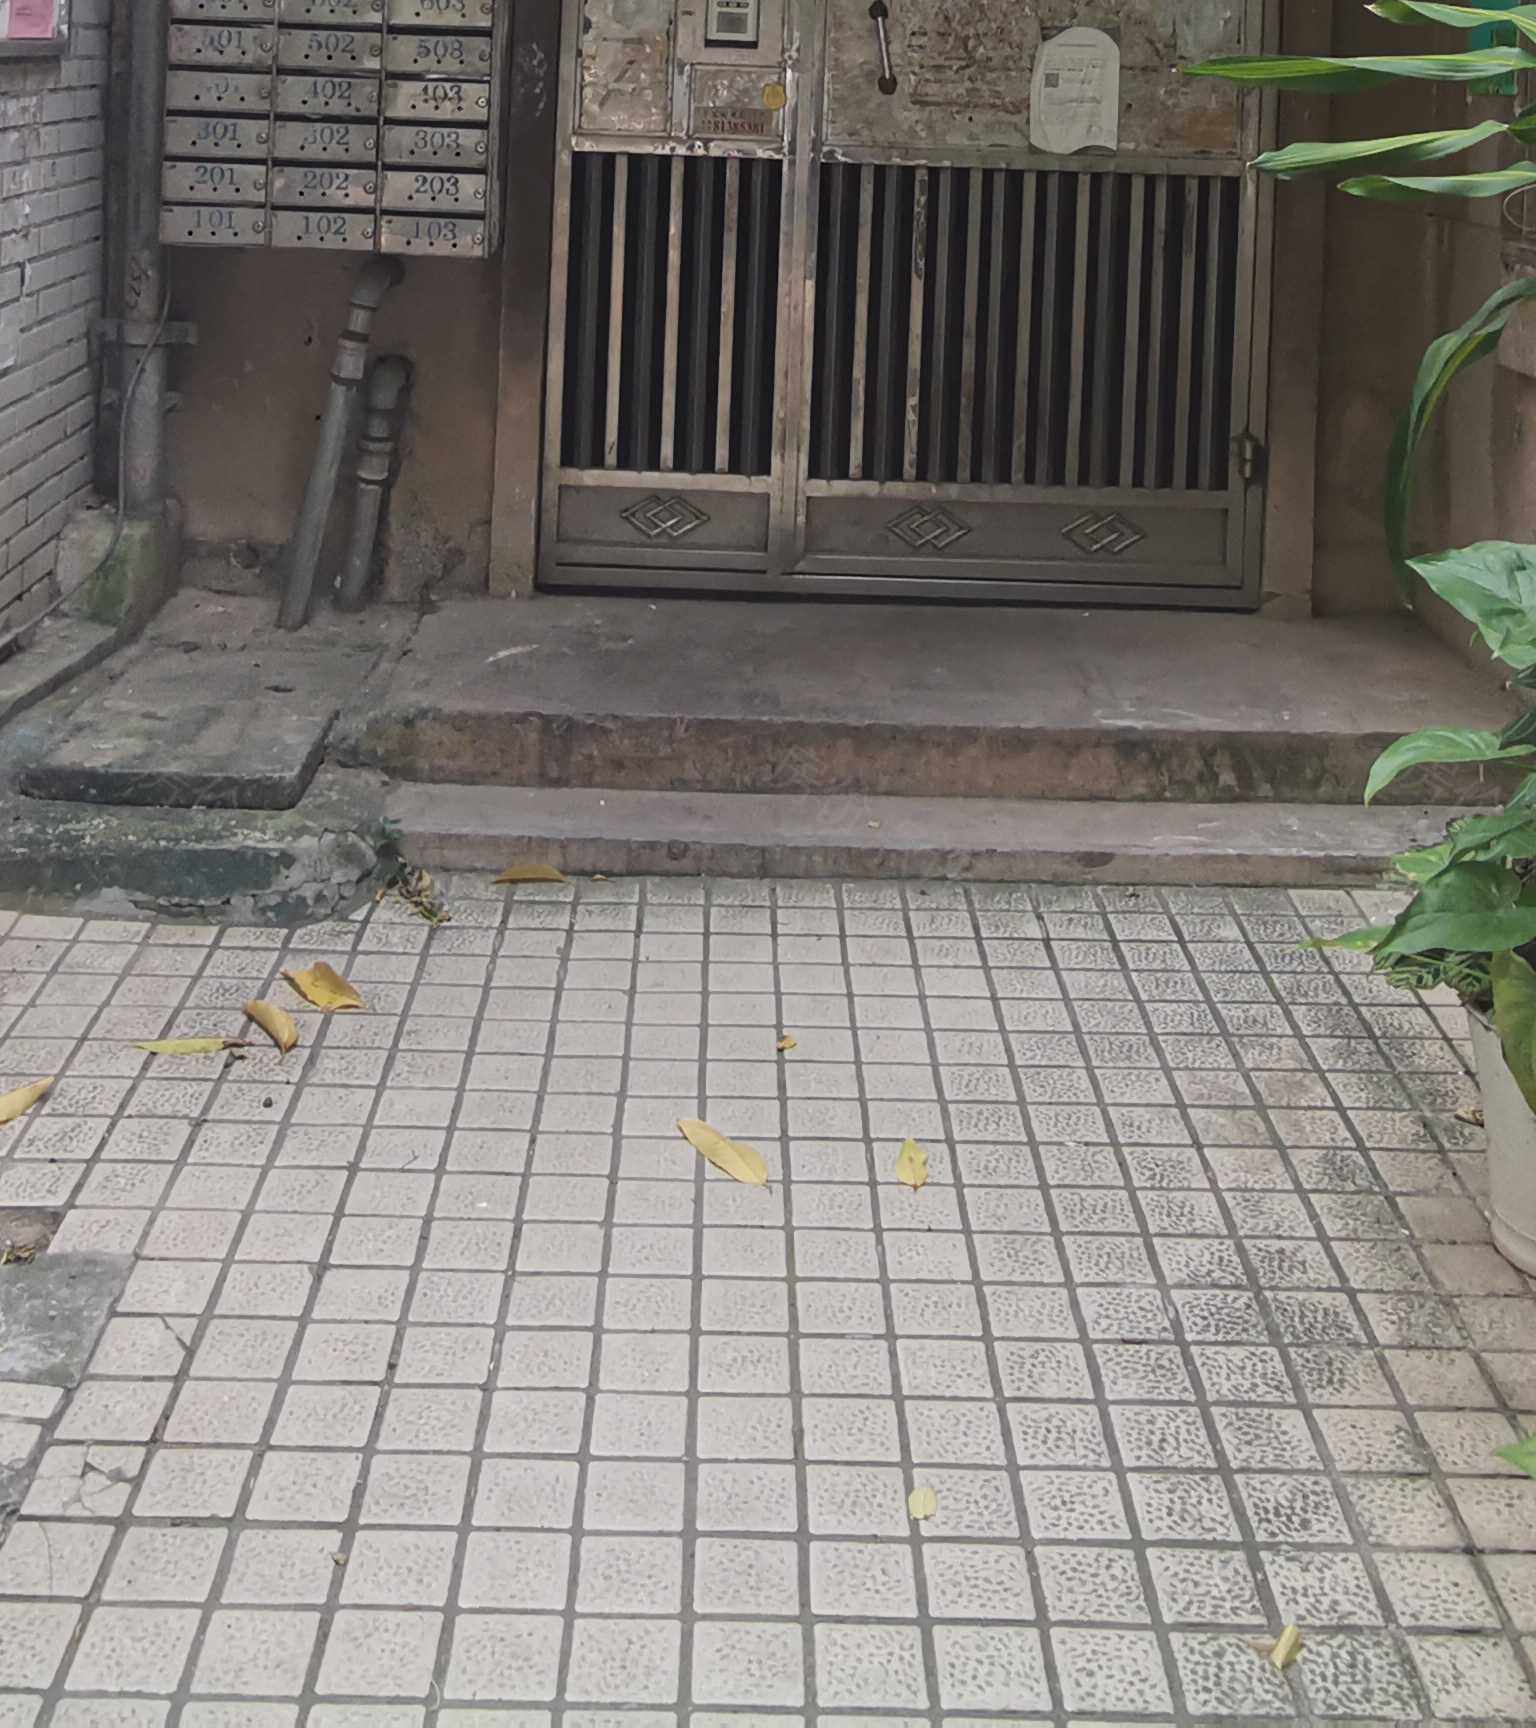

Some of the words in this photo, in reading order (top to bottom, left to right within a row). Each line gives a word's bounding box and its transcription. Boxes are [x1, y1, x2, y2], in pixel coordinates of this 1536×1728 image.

[309, 34, 354, 53] 502
[416, 39, 464, 58] 503
[414, 130, 461, 150] 303
[195, 166, 238, 186] 201
[303, 171, 350, 191] 202
[414, 175, 460, 195] 203
[195, 209, 235, 229] 101
[302, 215, 346, 235] 102
[413, 221, 457, 241] 103
